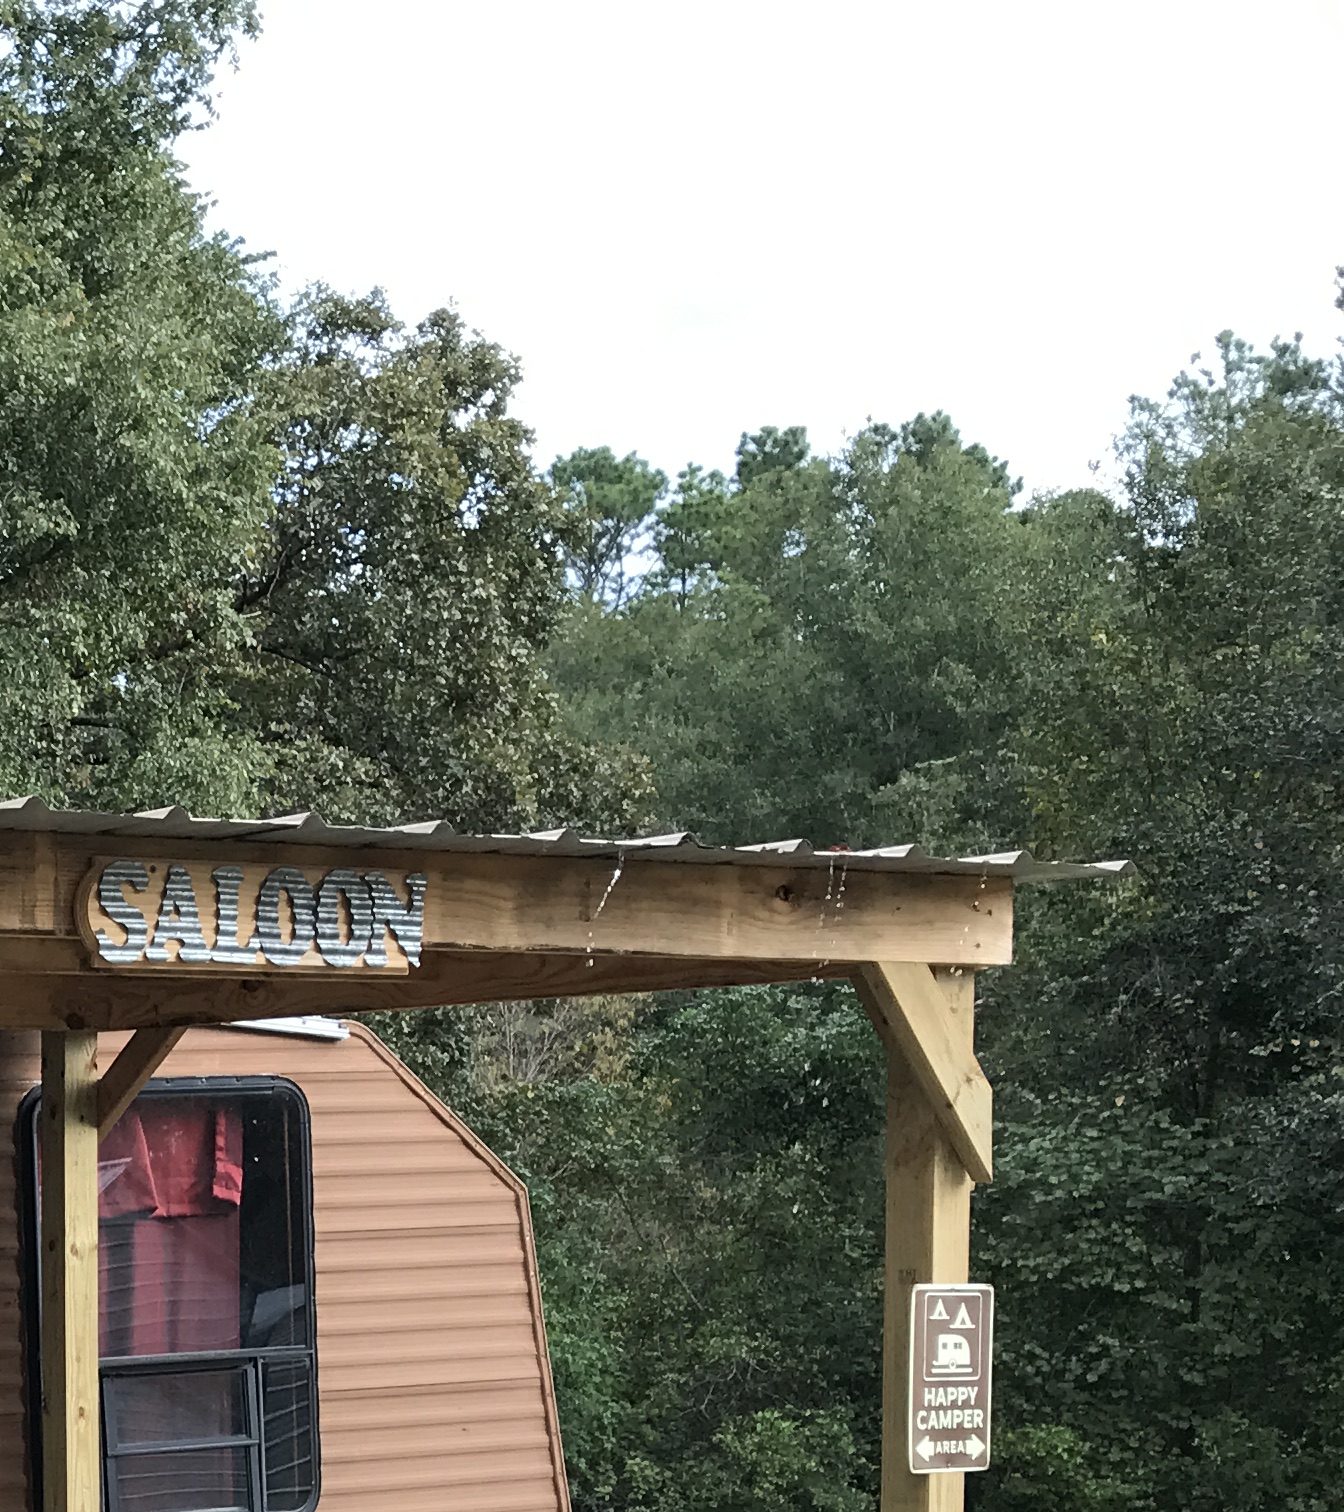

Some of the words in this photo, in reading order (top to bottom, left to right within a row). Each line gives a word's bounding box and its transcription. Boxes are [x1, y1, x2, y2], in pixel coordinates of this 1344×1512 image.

[96, 861, 428, 968] SALOON
[924, 1386, 978, 1407] HAPPY
[916, 1409, 984, 1430] CAMPER
[936, 1440, 965, 1454] AREA
